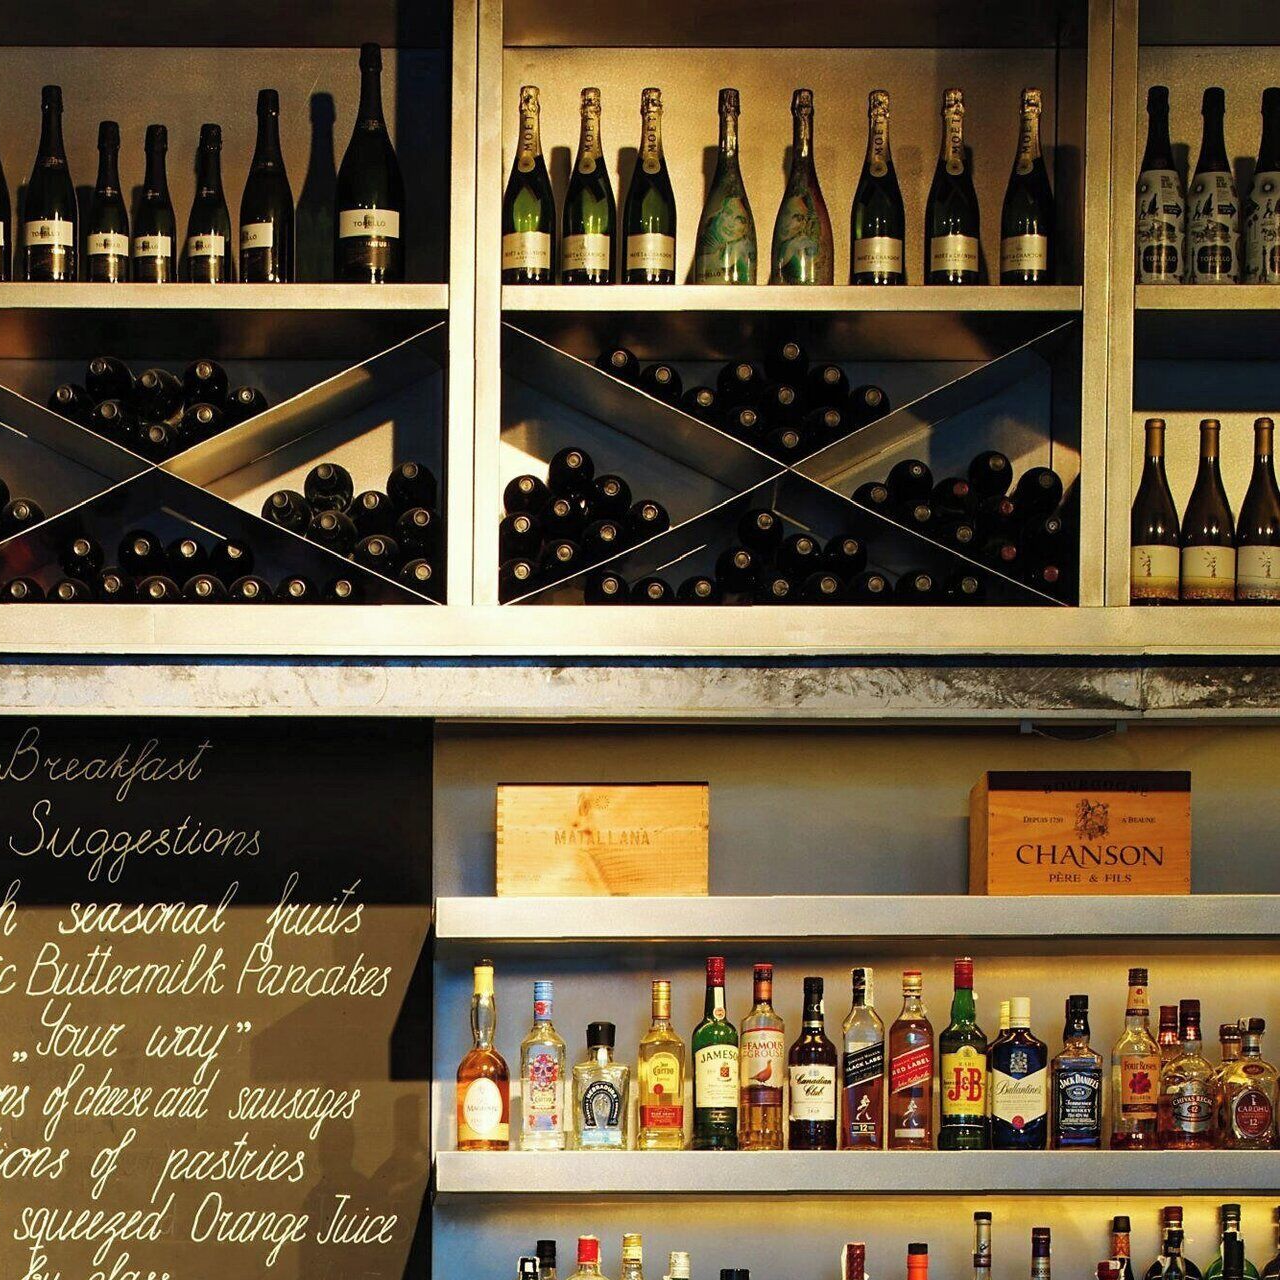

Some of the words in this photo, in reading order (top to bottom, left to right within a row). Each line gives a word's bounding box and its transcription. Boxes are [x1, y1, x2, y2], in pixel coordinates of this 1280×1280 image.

[10, 800, 261, 882] Suggestions
[554, 830, 651, 845] MATALLANA
[1016, 844, 1164, 869] CHANSON
[1048, 871, 1081, 883] PÈRE
[1089, 874, 1099, 883] &
[1105, 874, 1132, 883] FILS
[58, 881, 239, 935] seasonal
[264, 872, 362, 961] fruits
[26, 943, 227, 997] Buttermilk
[237, 943, 390, 997] Pancakes
[748, 1041, 785, 1050] FAMOUS
[700, 1049, 738, 1064] JAMESO
[748, 1050, 785, 1059] GROUSE
[891, 1066, 907, 1077] RED
[908, 1056, 930, 1071] LABEL
[794, 1071, 833, 1086] Canadian
[947, 1066, 986, 1103] J&B
[1059, 1075, 1075, 1089] JACK
[803, 1083, 825, 1098] Club
[995, 1079, 1042, 1096] Ballantine's
[42, 1064, 86, 1141] of
[73, 1069, 150, 1118] cheese
[154, 1069, 221, 1118] and
[229, 1088, 362, 1141] sausages
[1172, 1095, 1195, 1105] CHIVAS
[1237, 1105, 1270, 1114] CARDHU
[859, 1123, 868, 1132] 12
[1249, 1118, 1258, 1127] 12
[91, 1127, 136, 1199] of
[150, 1133, 305, 1204] pastries
[13, 1193, 176, 1265] squeezed
[190, 1191, 307, 1267] Orange
[317, 1194, 399, 1245] Juice
